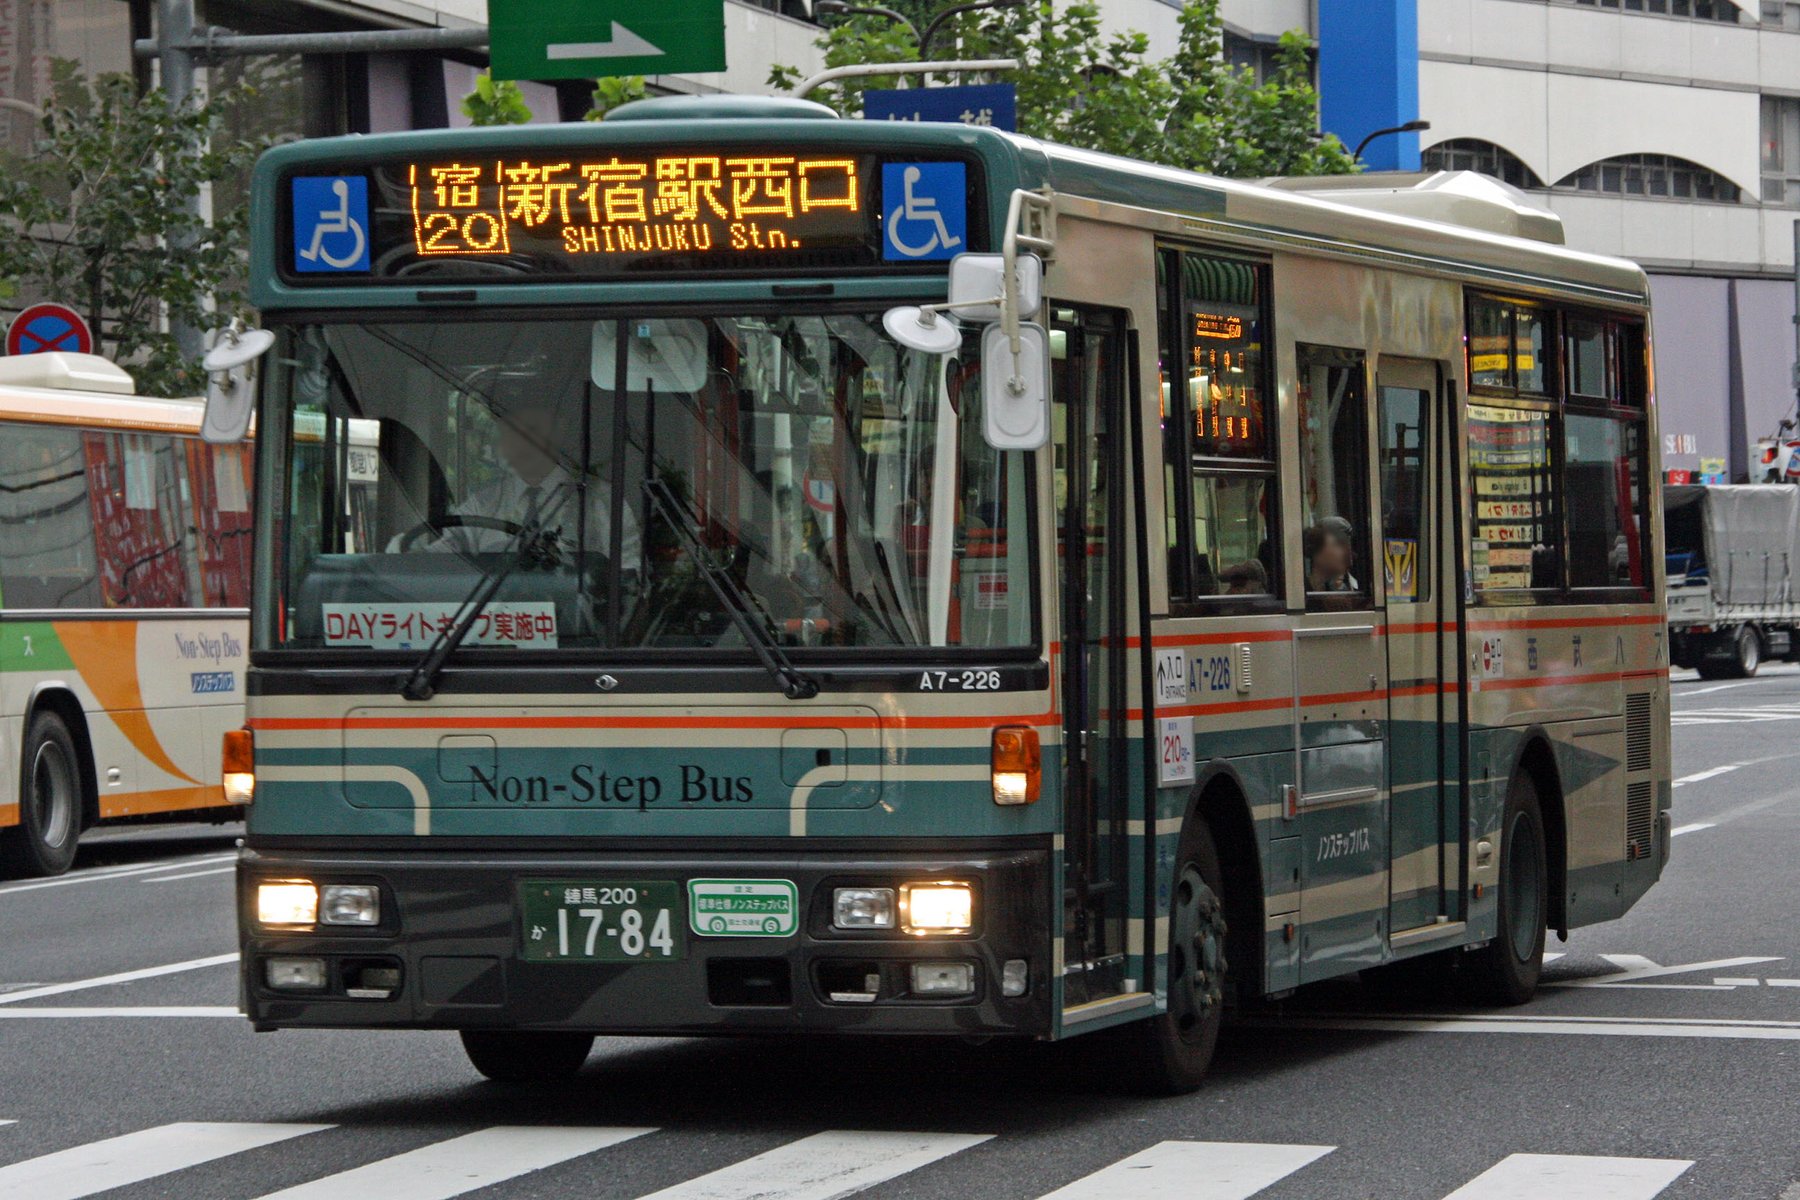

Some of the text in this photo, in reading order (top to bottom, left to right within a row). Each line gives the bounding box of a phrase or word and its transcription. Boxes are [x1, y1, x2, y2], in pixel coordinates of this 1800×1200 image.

[431, 164, 481, 207] 宿
[505, 157, 858, 226] 新宿駅西口
[424, 212, 500, 250] 20
[562, 222, 799, 252] SHINJUKU Stn.
[1664, 433, 1697, 455] SEIBU
[326, 611, 554, 641] DAYライトキプ実施中
[175, 631, 241, 665] Non-Step Bus
[919, 671, 1001, 690] A7-226
[1167, 656, 1182, 680] 入口
[1190, 656, 1231, 693] A7-226
[469, 765, 753, 812] Non-Step Bus
[1317, 828, 1370, 862] ノンステップバス
[564, 888, 637, 904] 練馬 200
[531, 925, 547, 941] か
[558, 908, 674, 956] 17-84
